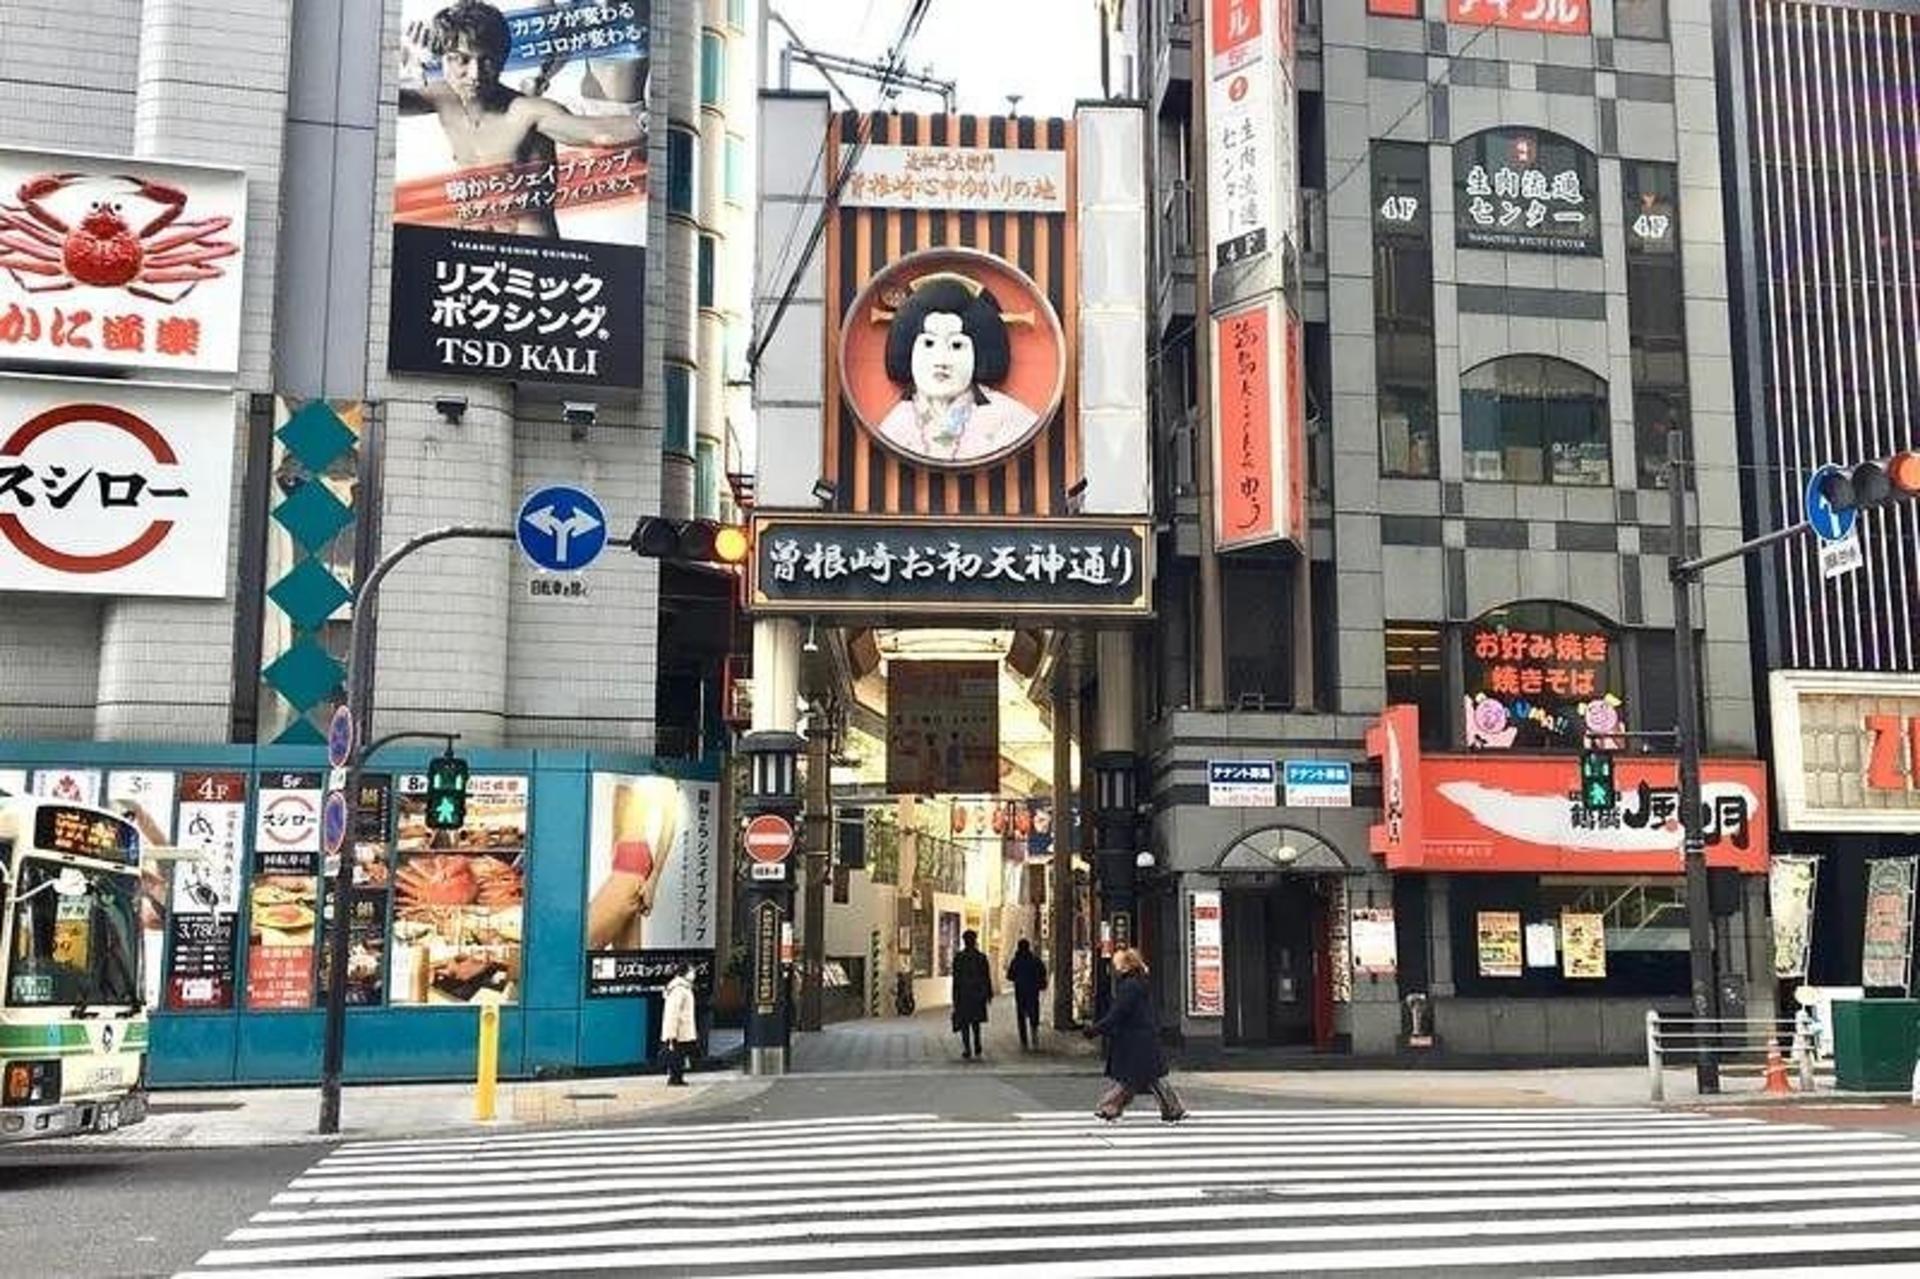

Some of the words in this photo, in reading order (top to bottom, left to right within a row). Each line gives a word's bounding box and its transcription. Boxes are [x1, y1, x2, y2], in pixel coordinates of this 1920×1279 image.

[513, 3, 635, 36] カラダが変わる
[520, 25, 642, 58] ココロが変わる
[1466, 165, 1583, 204] 生肉流通
[1382, 196, 1417, 222] 4F
[1468, 196, 1585, 229] センター
[1632, 215, 1669, 239] 4F
[436, 261, 603, 304] リズミック
[436, 337, 512, 367] TSD
[520, 344, 599, 375] KALI
[0, 463, 190, 509] スシロー
[769, 539, 1134, 585] 曽根崎お初天神通り
[1475, 632, 1607, 661] お好み焼き
[1492, 666, 1596, 695] 焼きそば
[198, 778, 230, 800] 4F
[282, 774, 301, 788] 5F
[262, 812, 317, 827] スシロー
